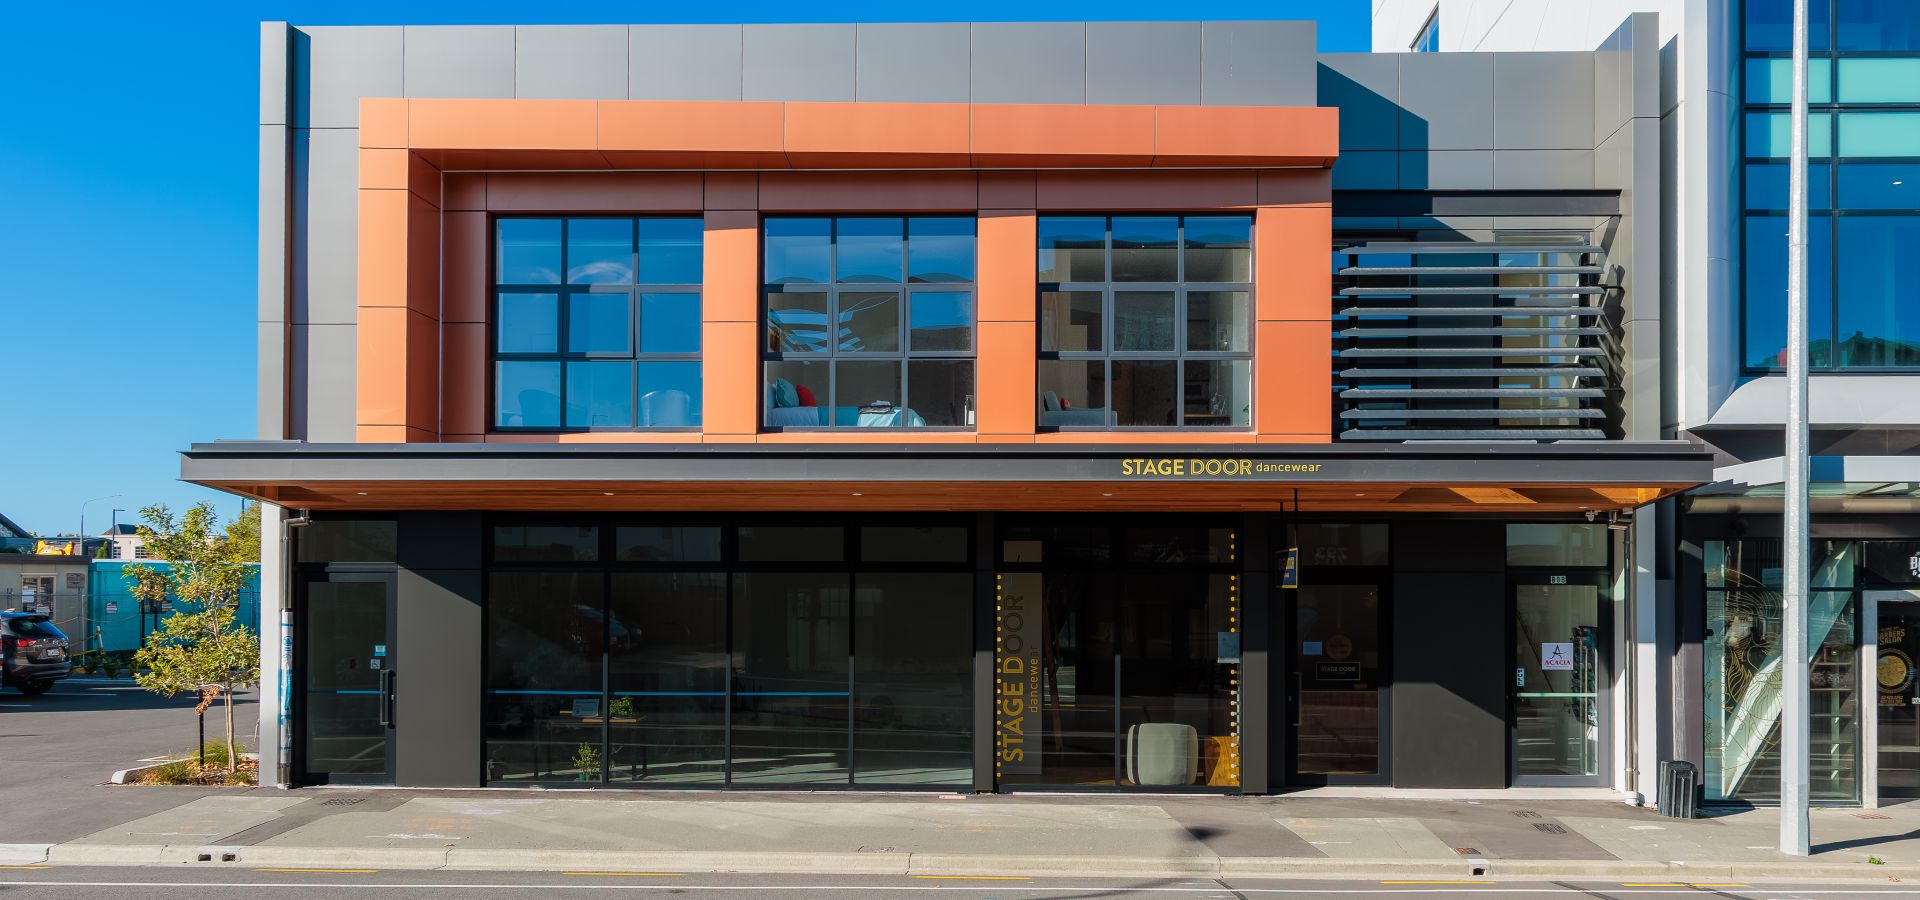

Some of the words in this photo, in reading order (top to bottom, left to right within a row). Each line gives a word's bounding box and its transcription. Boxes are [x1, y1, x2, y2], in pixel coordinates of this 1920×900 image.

[1122, 459, 1185, 475] STAGE
[1190, 459, 1252, 475] DOOR
[1256, 462, 1321, 472] dancewear
[1003, 594, 1024, 674] DOOR
[1028, 646, 1039, 713] dancewear
[1003, 682, 1024, 762] STAGE
